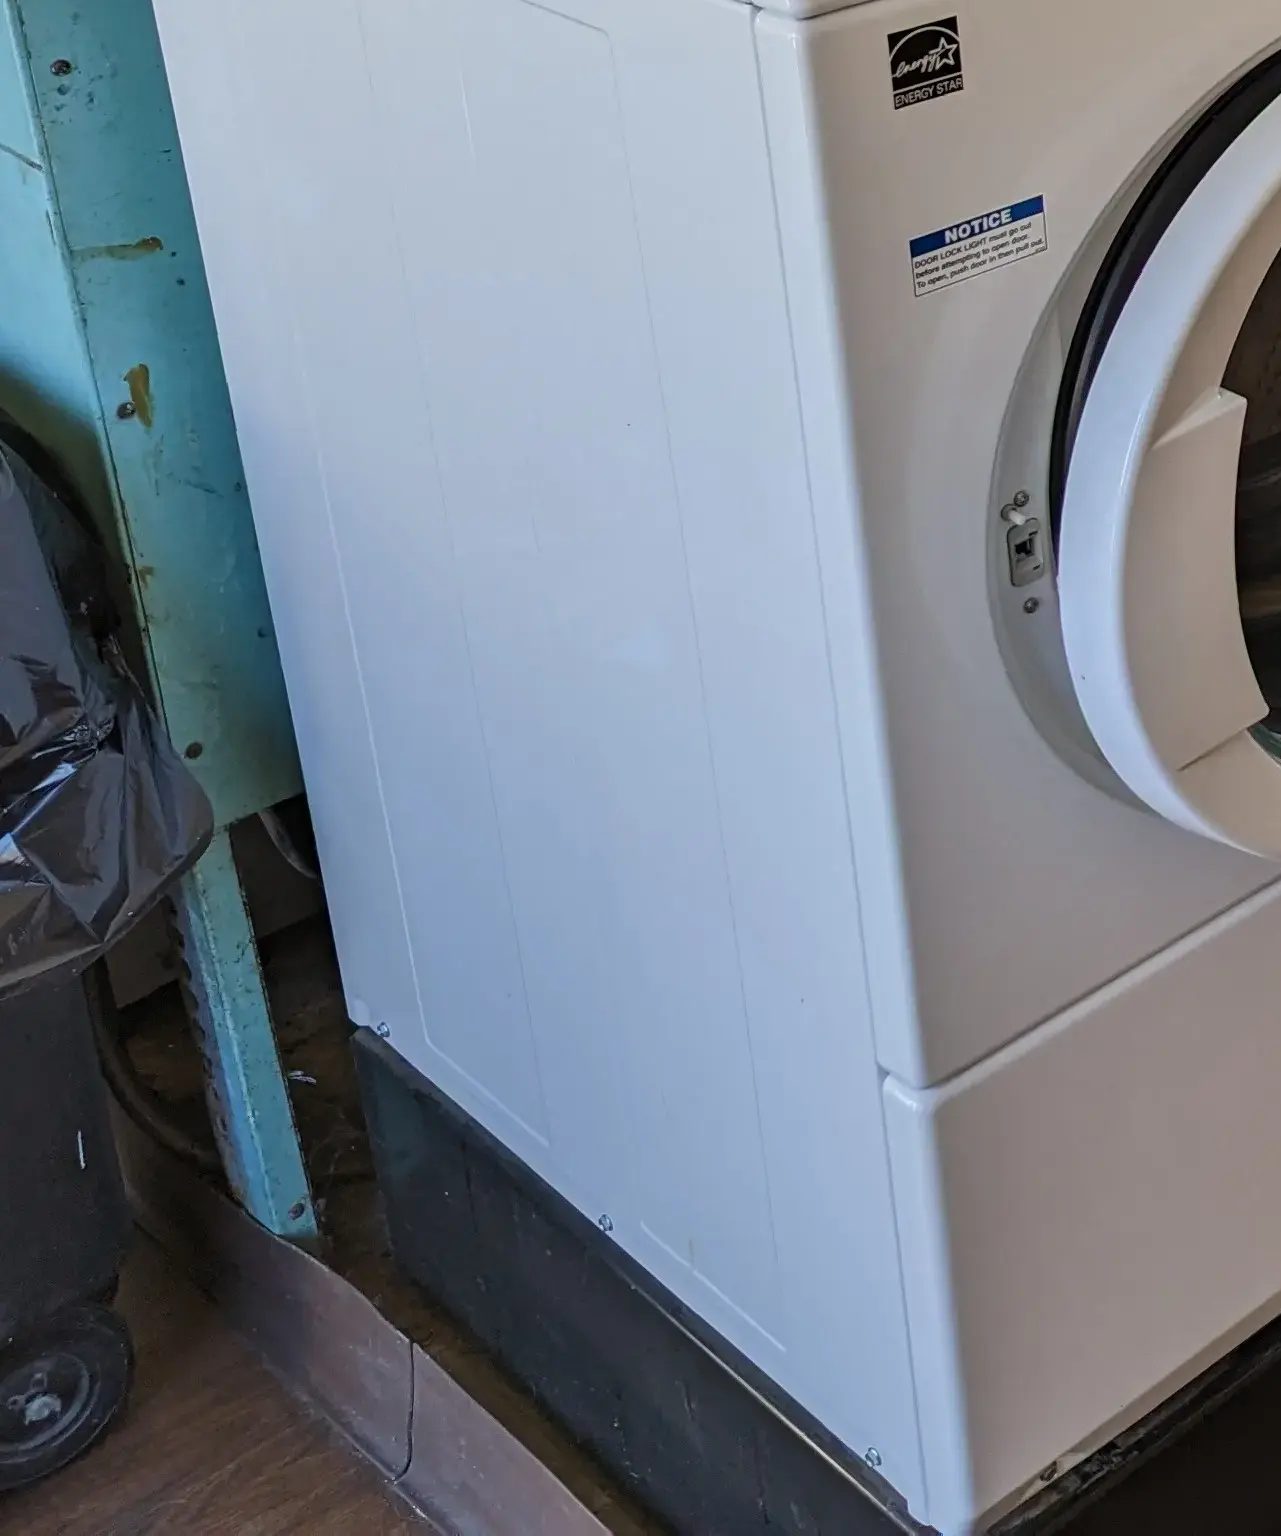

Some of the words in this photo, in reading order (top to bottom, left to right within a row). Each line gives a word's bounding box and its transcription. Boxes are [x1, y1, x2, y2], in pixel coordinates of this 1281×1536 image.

[895, 85, 935, 108] ENERGY
[936, 77, 963, 95] STAR
[944, 208, 1012, 244] NOTICE
